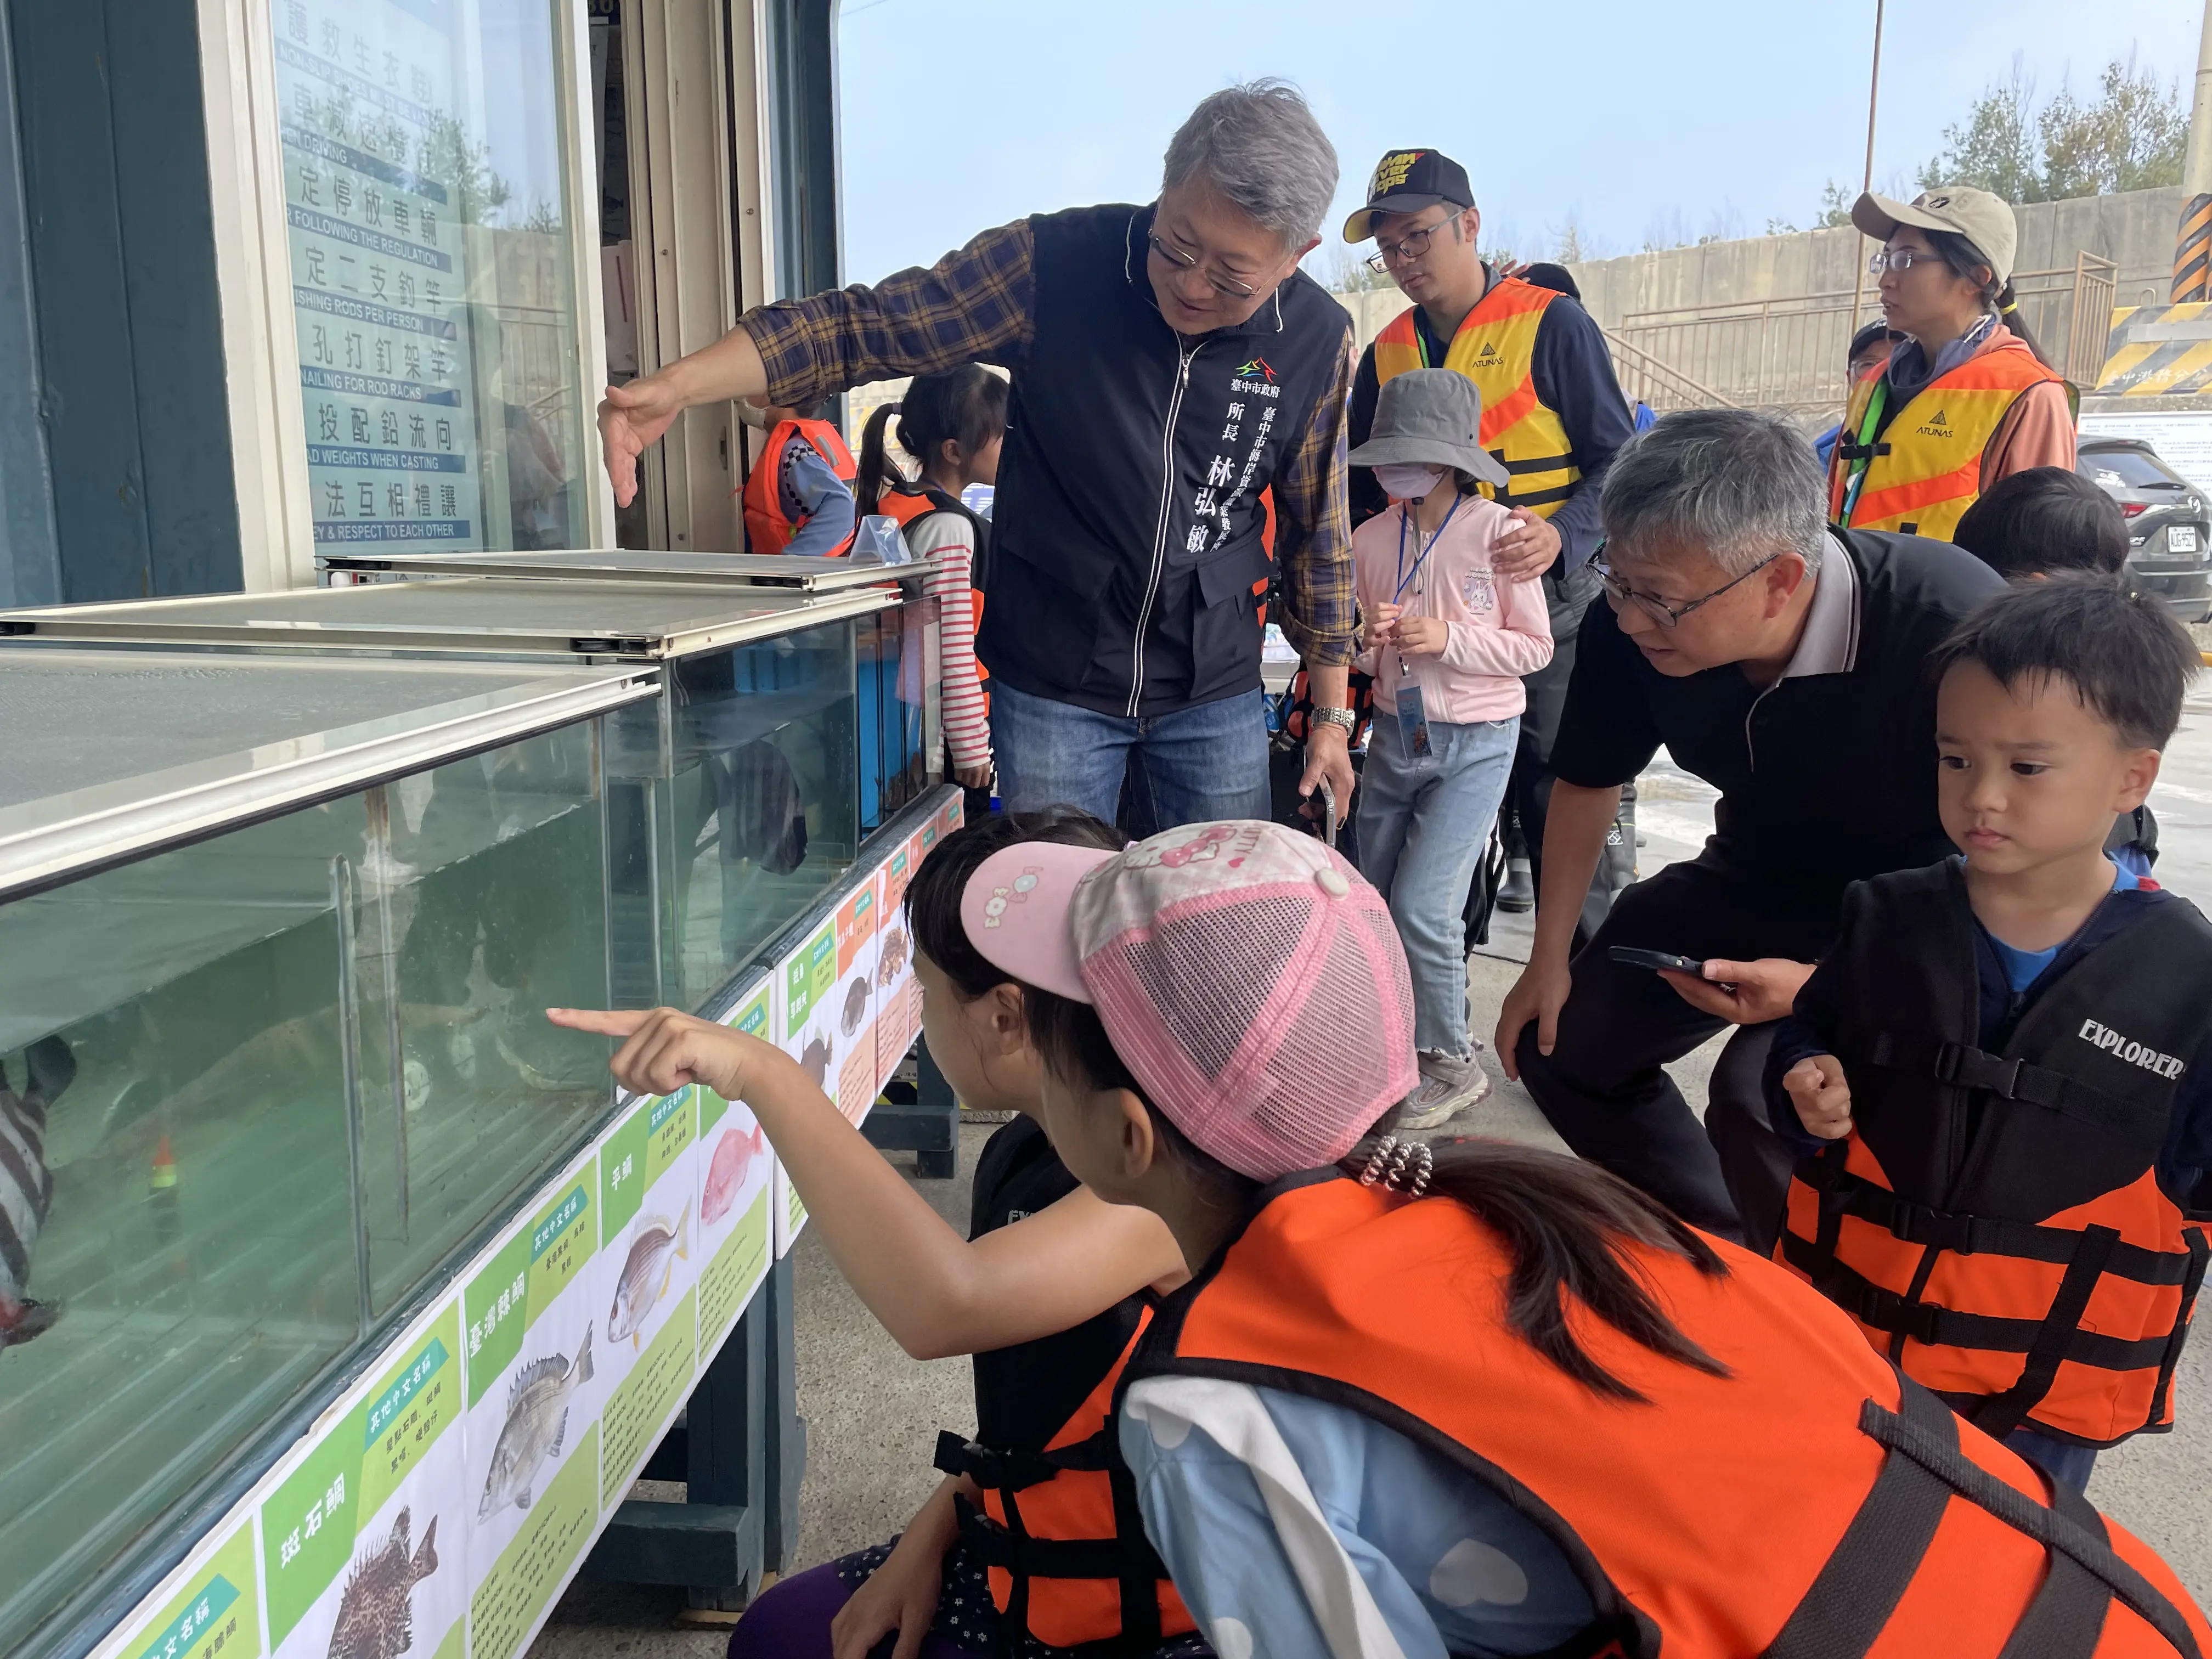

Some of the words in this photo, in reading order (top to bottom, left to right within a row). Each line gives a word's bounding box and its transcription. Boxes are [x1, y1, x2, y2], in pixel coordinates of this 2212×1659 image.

[304, 134, 347, 163] DRIVING
[300, 166, 437, 246] 定停放車輛
[295, 211, 358, 243] FOLLOWING
[360, 231, 380, 249] THE
[381, 238, 438, 267] REGULATION
[306, 246, 441, 313] 定二支釣竿
[335, 298, 363, 318] RODS
[365, 306, 385, 324] PER
[387, 311, 424, 331] PERSON
[312, 324, 447, 381] 孔打釘架竿
[1472, 357, 1504, 368] ATUNAS
[300, 370, 342, 389] NAILING
[345, 376, 365, 393] FOR
[368, 381, 388, 395] ROD
[391, 385, 421, 400] RACKS
[1231, 379, 1280, 398] 臺中市政府
[319, 403, 451, 450] 投配鉛流向
[1222, 402, 1245, 442] 所長
[1916, 426, 1953, 438] ATUNAS
[321, 450, 369, 466] WEIGHTS
[370, 453, 399, 468] WHEN
[401, 454, 439, 470] CASTING
[325, 480, 456, 517] 法互相禮讓
[1186, 454, 1236, 554] 林弘敏
[329, 525, 335, 539] &
[338, 524, 383, 539] RESPECT
[385, 524, 398, 538] TO
[400, 524, 424, 538] EACH
[426, 523, 454, 537] OTHER
[2078, 1018, 2185, 1080] EXPLORER
[611, 1152, 632, 1190] 平鯛
[534, 1196, 577, 1251] 其他中文名稱
[470, 1271, 524, 1358] 臺灣棘鯛
[370, 1353, 431, 1434] 其他中文名稱
[281, 1472, 345, 1570] 斑石鯛
